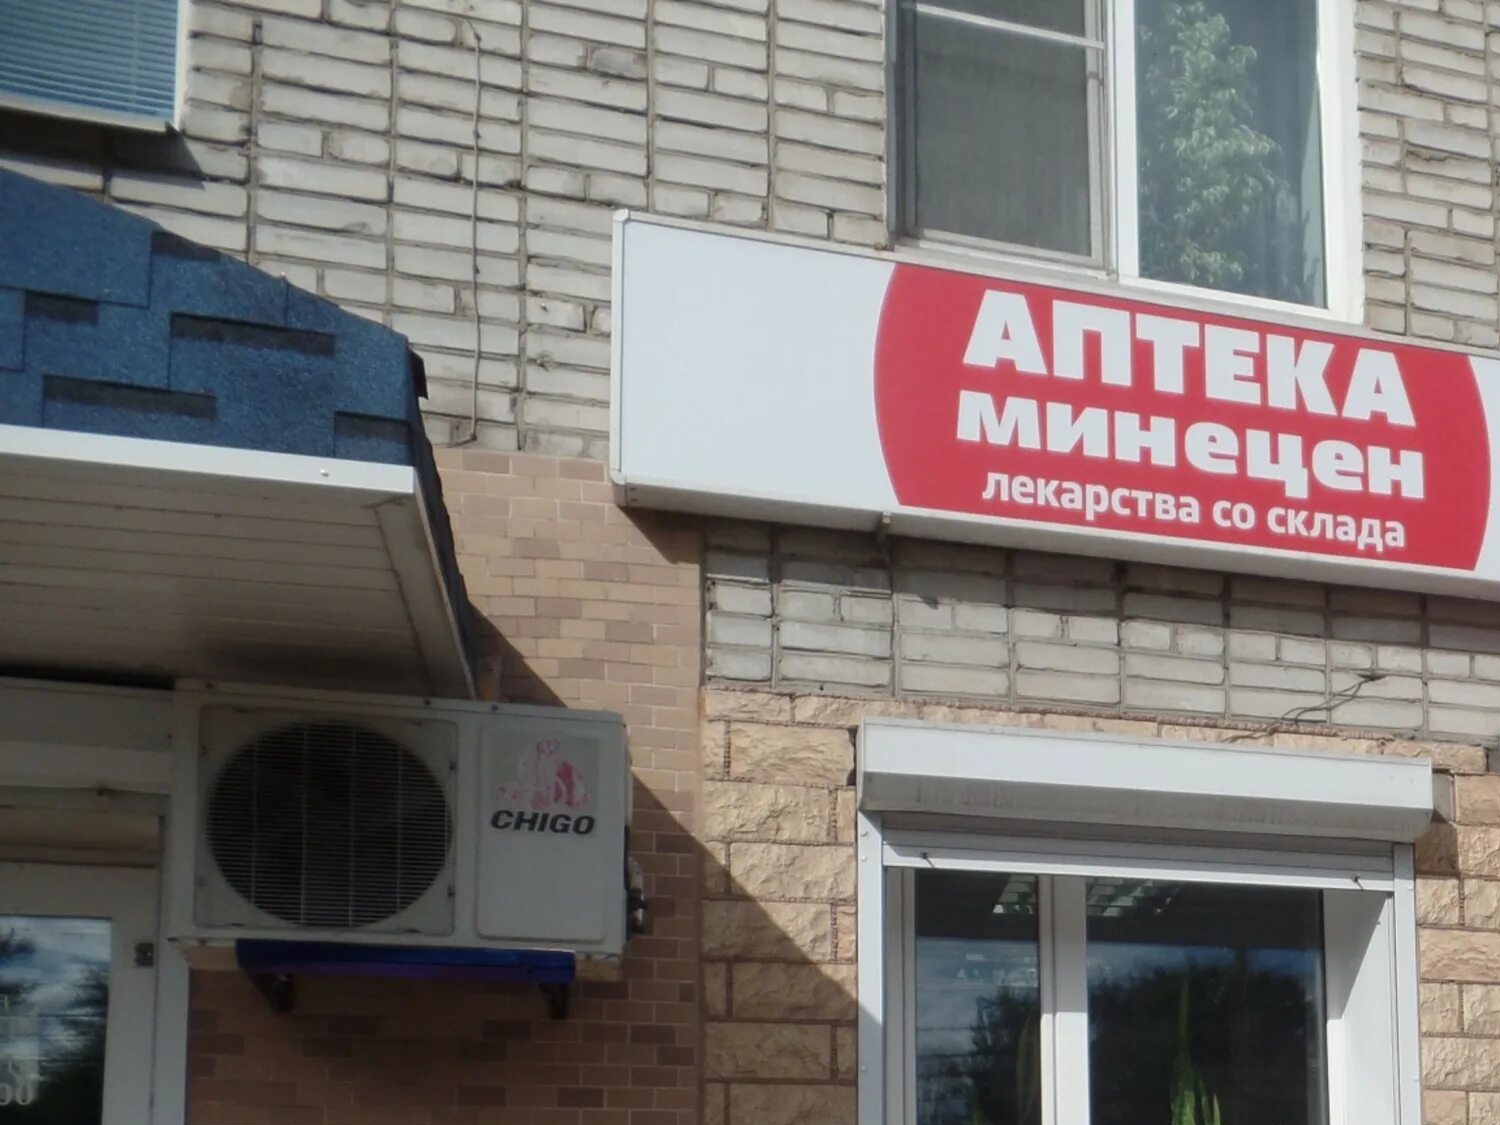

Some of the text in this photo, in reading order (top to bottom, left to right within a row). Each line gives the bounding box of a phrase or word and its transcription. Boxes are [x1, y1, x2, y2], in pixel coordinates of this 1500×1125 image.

[963, 289, 1416, 427] АПТЕКА
[982, 472, 1406, 553] лекарства со склада
[490, 809, 596, 836] CHIGO
